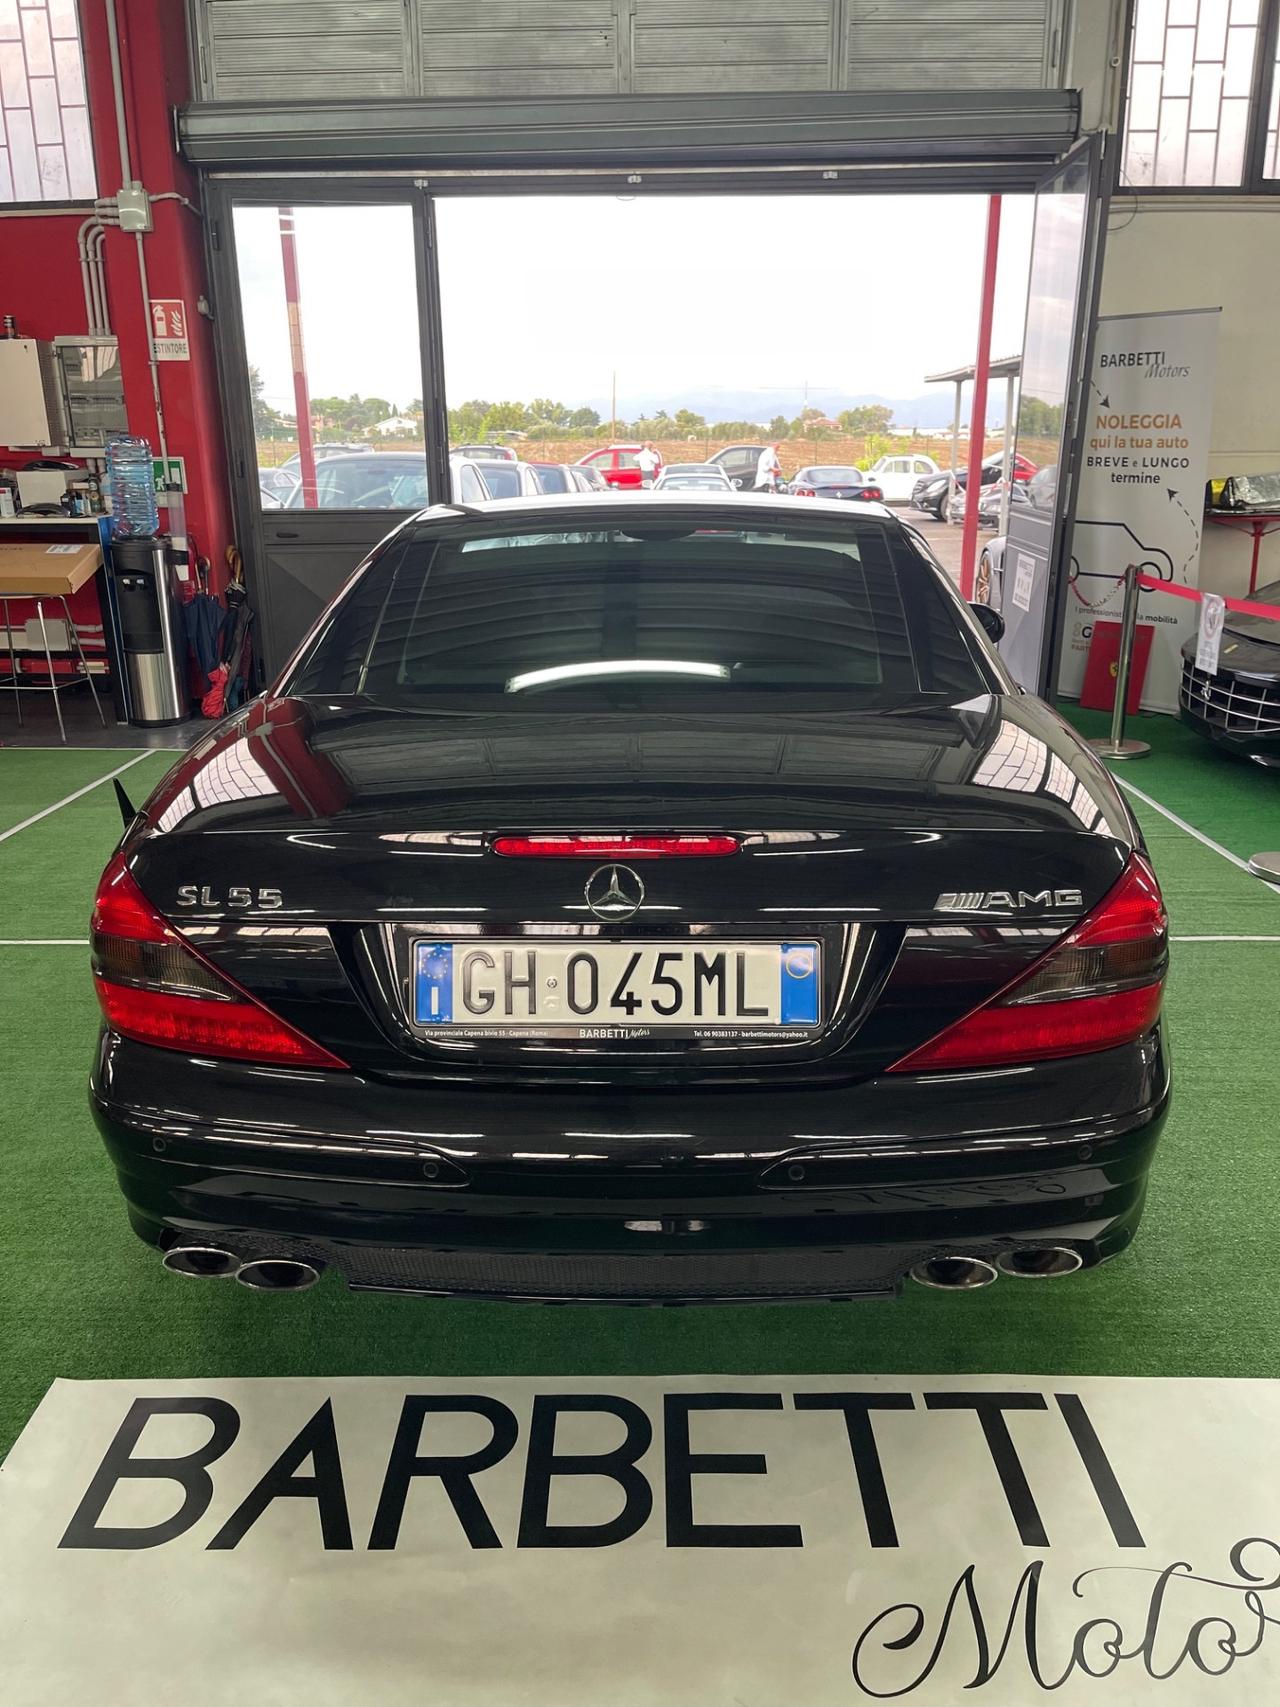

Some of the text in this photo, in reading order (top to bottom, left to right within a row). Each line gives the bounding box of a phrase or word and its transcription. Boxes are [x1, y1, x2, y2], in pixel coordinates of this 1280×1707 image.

[153, 343, 188, 354] ESTINTORE
[1100, 351, 1165, 368] BARBETTI
[1144, 363, 1190, 378] Motors
[1096, 414, 1182, 429] NOLEGGIA
[1090, 435, 1189, 451] qui la tua auto
[1087, 456, 1129, 467] BREVE
[1142, 457, 1190, 468] LUNGO
[1111, 472, 1161, 484] termine
[1079, 607, 1123, 619] professionist
[1145, 615, 1178, 625] mobilità
[981, 889, 1083, 910] AMG
[431, 986, 439, 1015] I
[424, 1029, 434, 1037] Via
[434, 1030, 463, 1038] provinciale
[464, 1030, 484, 1038] Capena
[509, 1030, 529, 1038] Capena
[580, 1029, 628, 1038] BARBETTI
[694, 1030, 703, 1038] Tel.
[703, 1030, 711, 1038] 06
[741, 1030, 808, 1038] barbettimotors@yahoo.it
[57, 1393, 1146, 1549] BARBETTI
